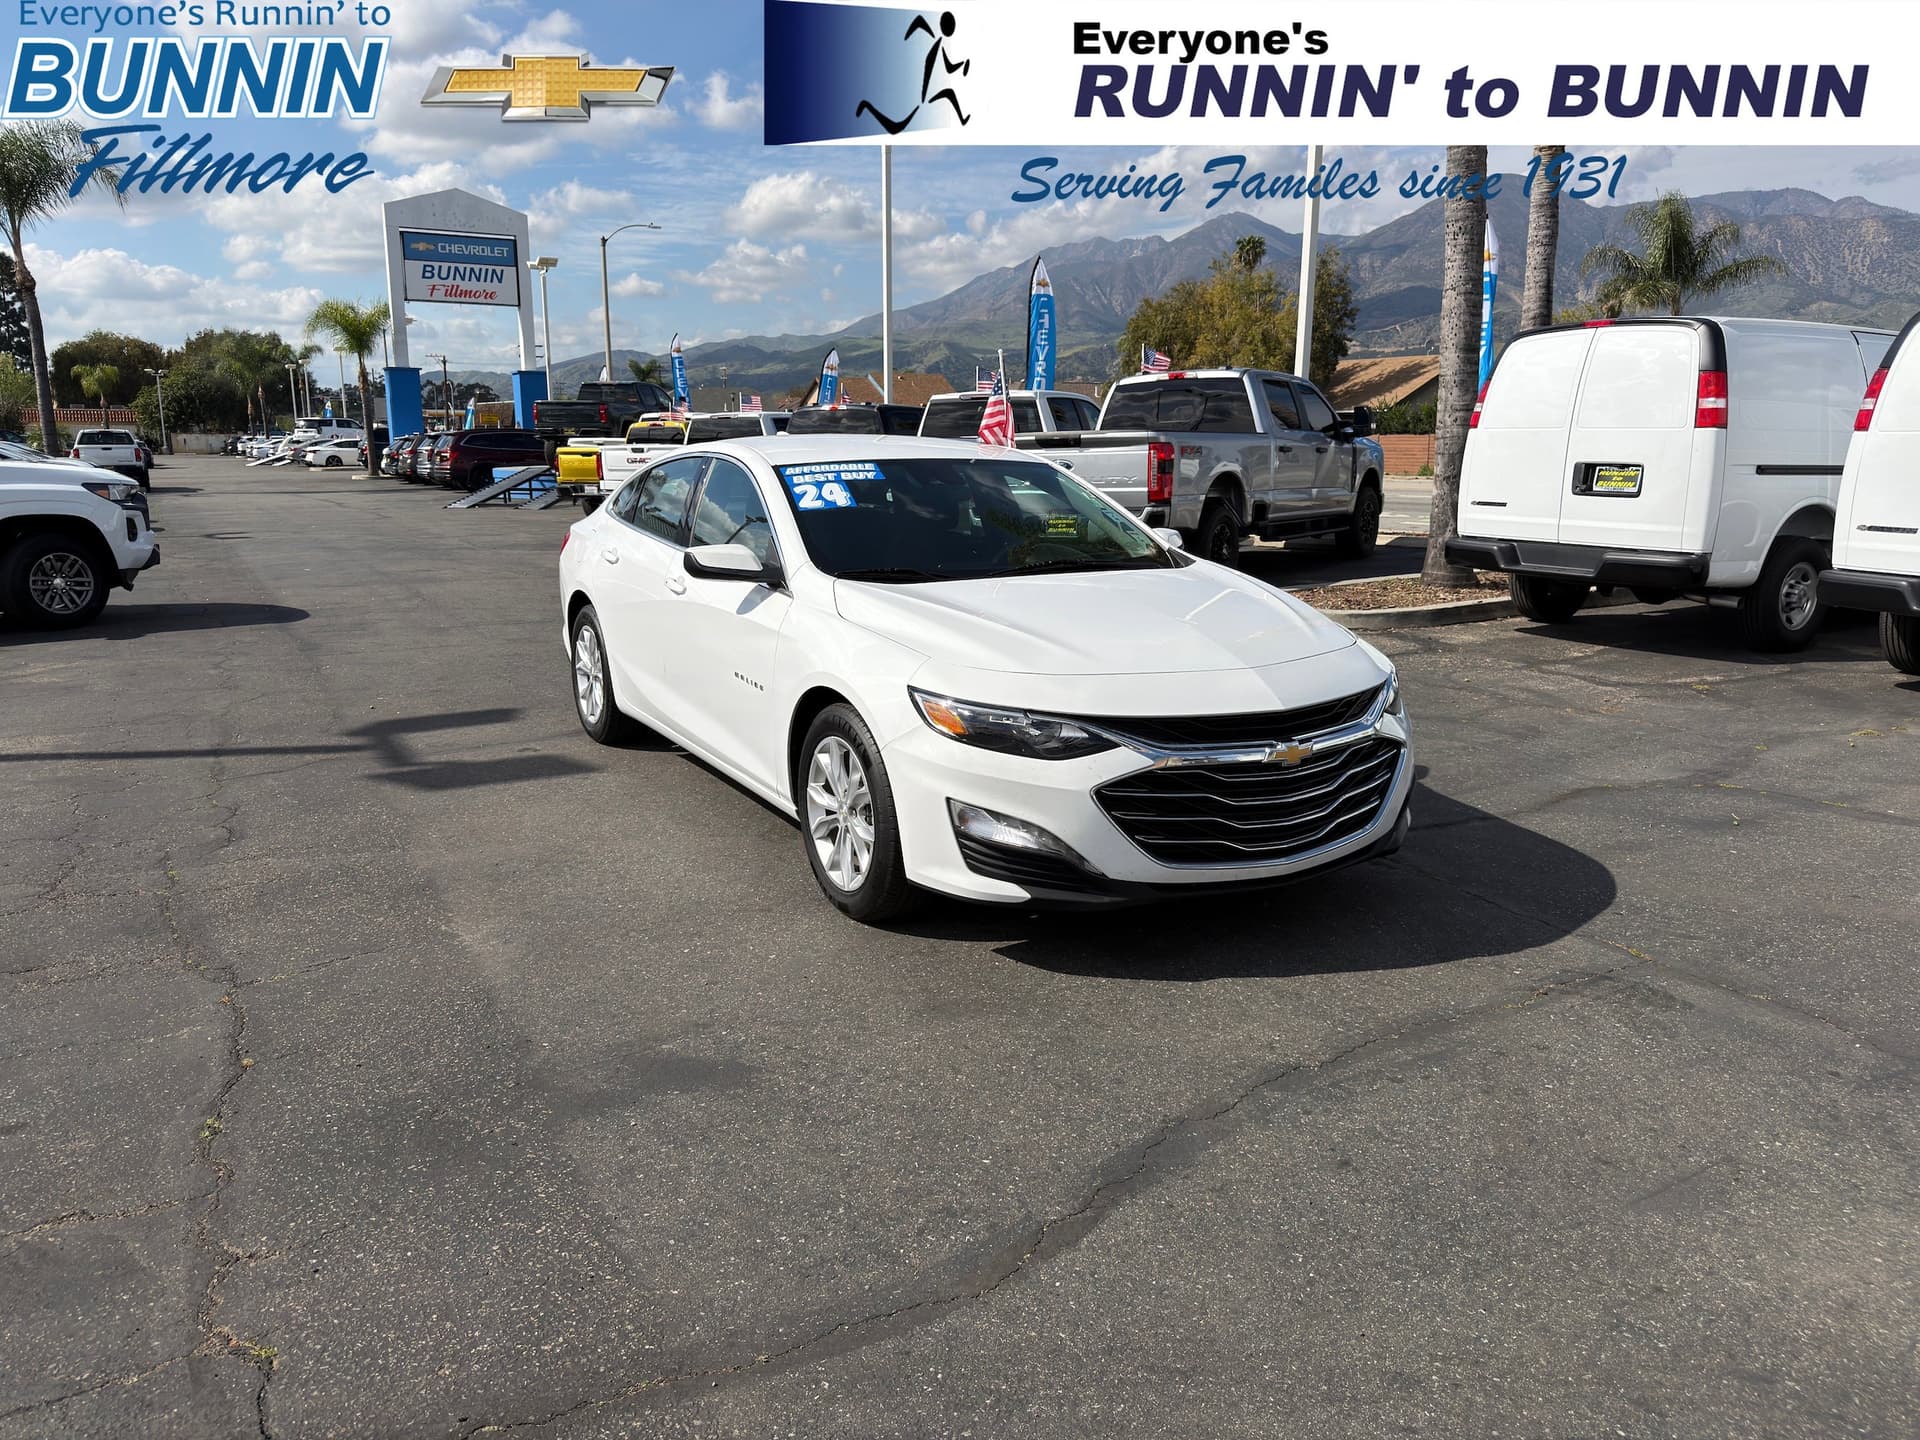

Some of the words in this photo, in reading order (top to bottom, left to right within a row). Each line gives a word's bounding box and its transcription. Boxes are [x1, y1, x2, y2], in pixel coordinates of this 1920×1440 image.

[438, 243, 509, 257] CHEVROLET
[421, 264, 504, 284] BUNNIN
[426, 284, 497, 300] Fillmore
[785, 463, 875, 475] AFFORDABLE
[792, 472, 837, 484] BEST
[840, 471, 877, 480] BUY
[793, 481, 852, 508] 24
